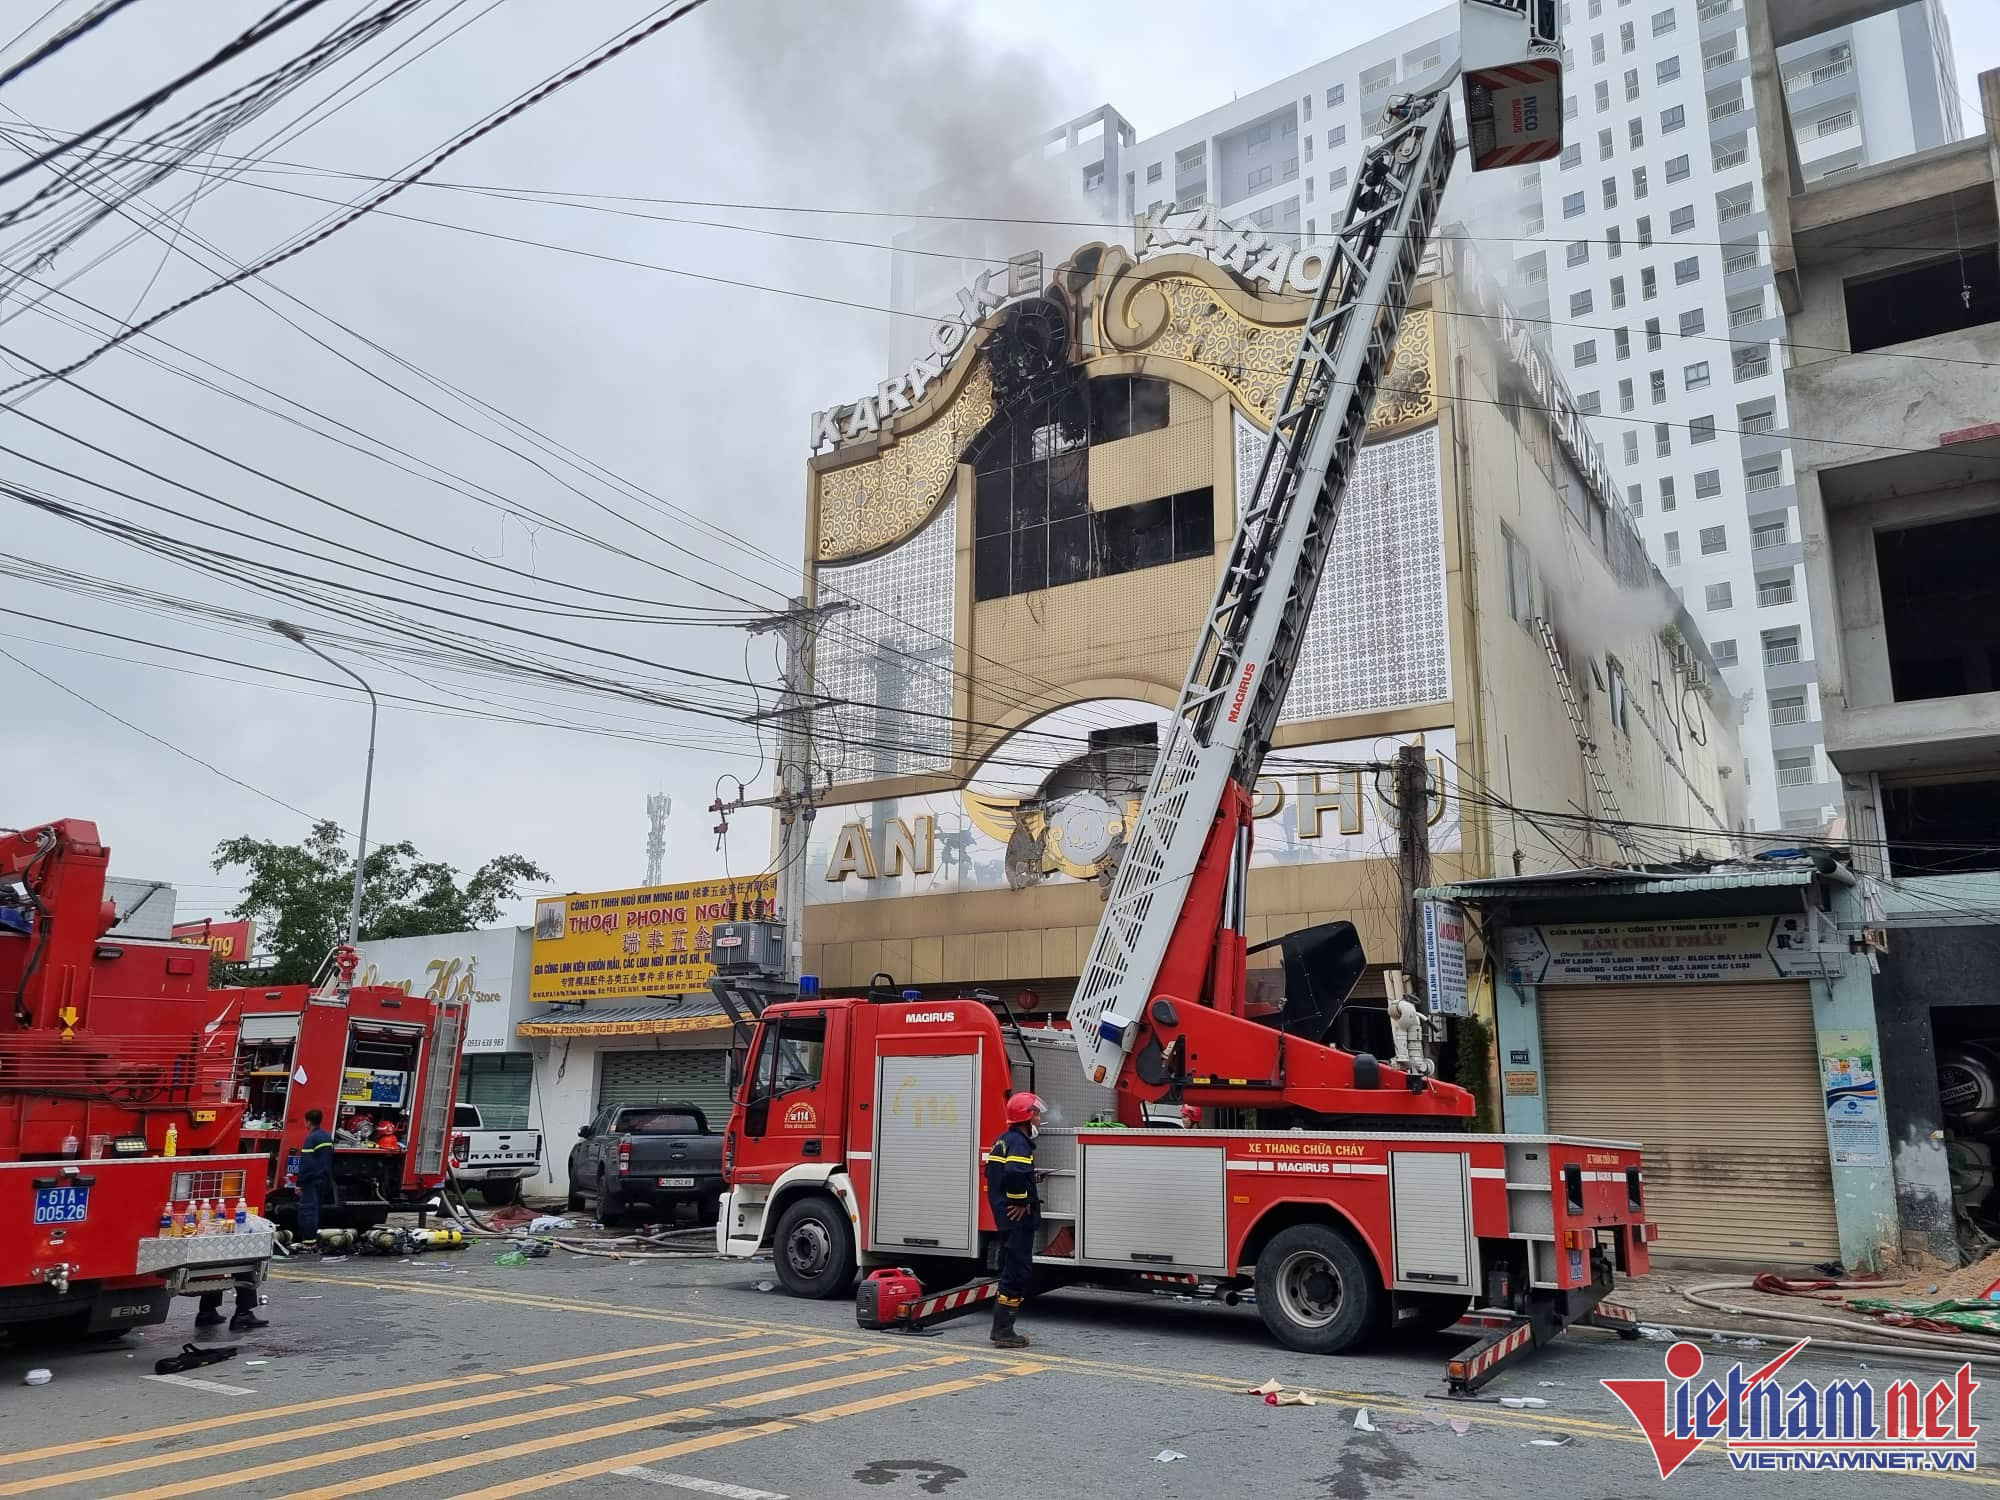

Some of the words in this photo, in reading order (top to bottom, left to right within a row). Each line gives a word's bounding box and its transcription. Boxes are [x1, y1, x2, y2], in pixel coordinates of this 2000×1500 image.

[1524, 95, 1538, 132] IVECO
[1135, 201, 1442, 294] KARAOE
[810, 249, 1043, 450] KARAOKE
[1228, 662, 1256, 724] MAGIRUS
[825, 815, 935, 882] AN
[570, 899, 589, 912] CÔNG
[591, 899, 598, 910] TY
[601, 897, 619, 908] TNHH
[637, 893, 652, 904] KIM
[653, 891, 673, 902] MING
[674, 889, 690, 901] HAO
[569, 912, 620, 936] THOẠI
[626, 906, 687, 928] PHONG
[475, 990, 502, 1002] Store
[905, 1012, 955, 1024] MAGIRUS
[470, 1152, 535, 1161] RANGER
[1248, 1143, 1262, 1153] XE
[1264, 1143, 1300, 1154] THANG
[1303, 1142, 1333, 1155] CHỮA
[1335, 1143, 1365, 1156] CHÁY
[1276, 1161, 1330, 1173] MAGIRUS
[48, 1188, 76, 1205] 61A
[36, 1203, 86, 1222] 005.26
